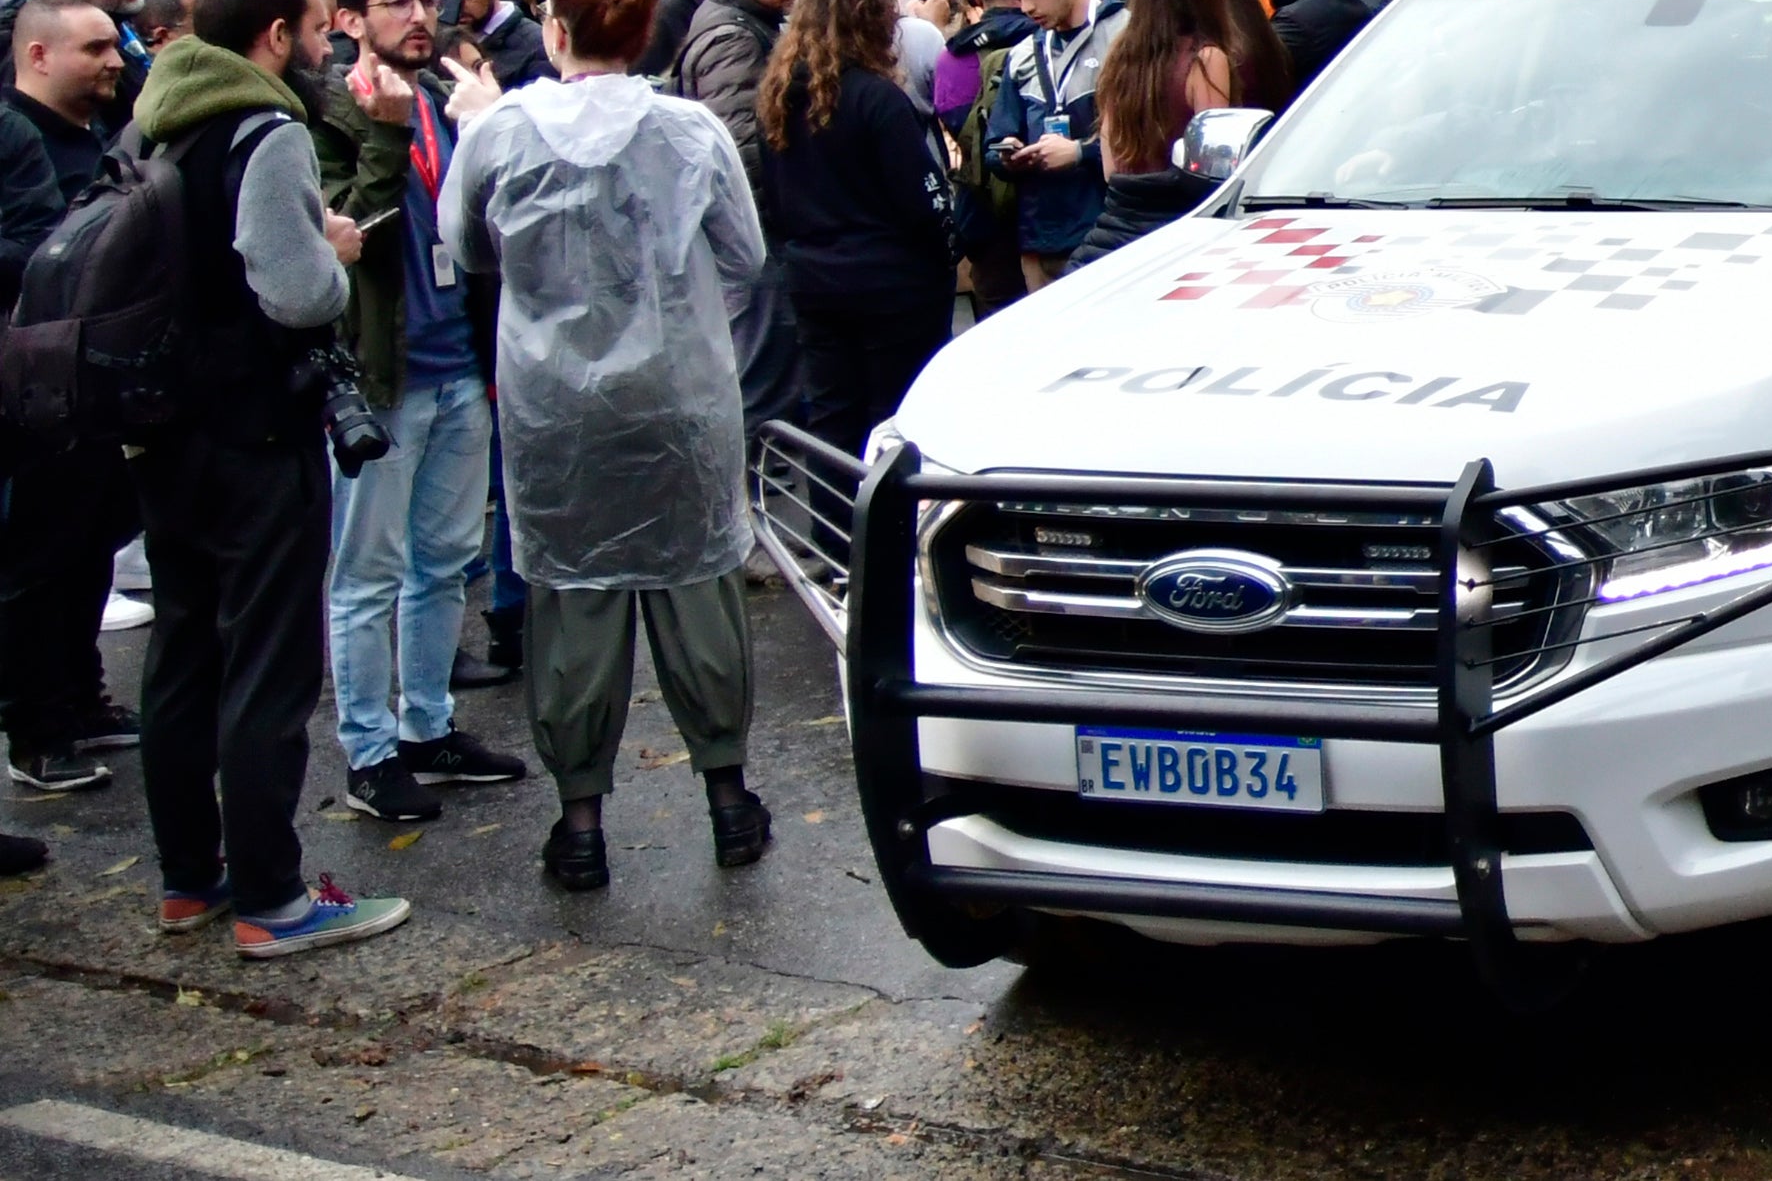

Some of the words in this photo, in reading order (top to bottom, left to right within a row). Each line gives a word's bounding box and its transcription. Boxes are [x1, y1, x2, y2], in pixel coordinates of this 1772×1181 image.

[1037, 362, 1531, 413] POLÍCIA
[1169, 573, 1245, 611] Ford
[1081, 779, 1095, 793] BR
